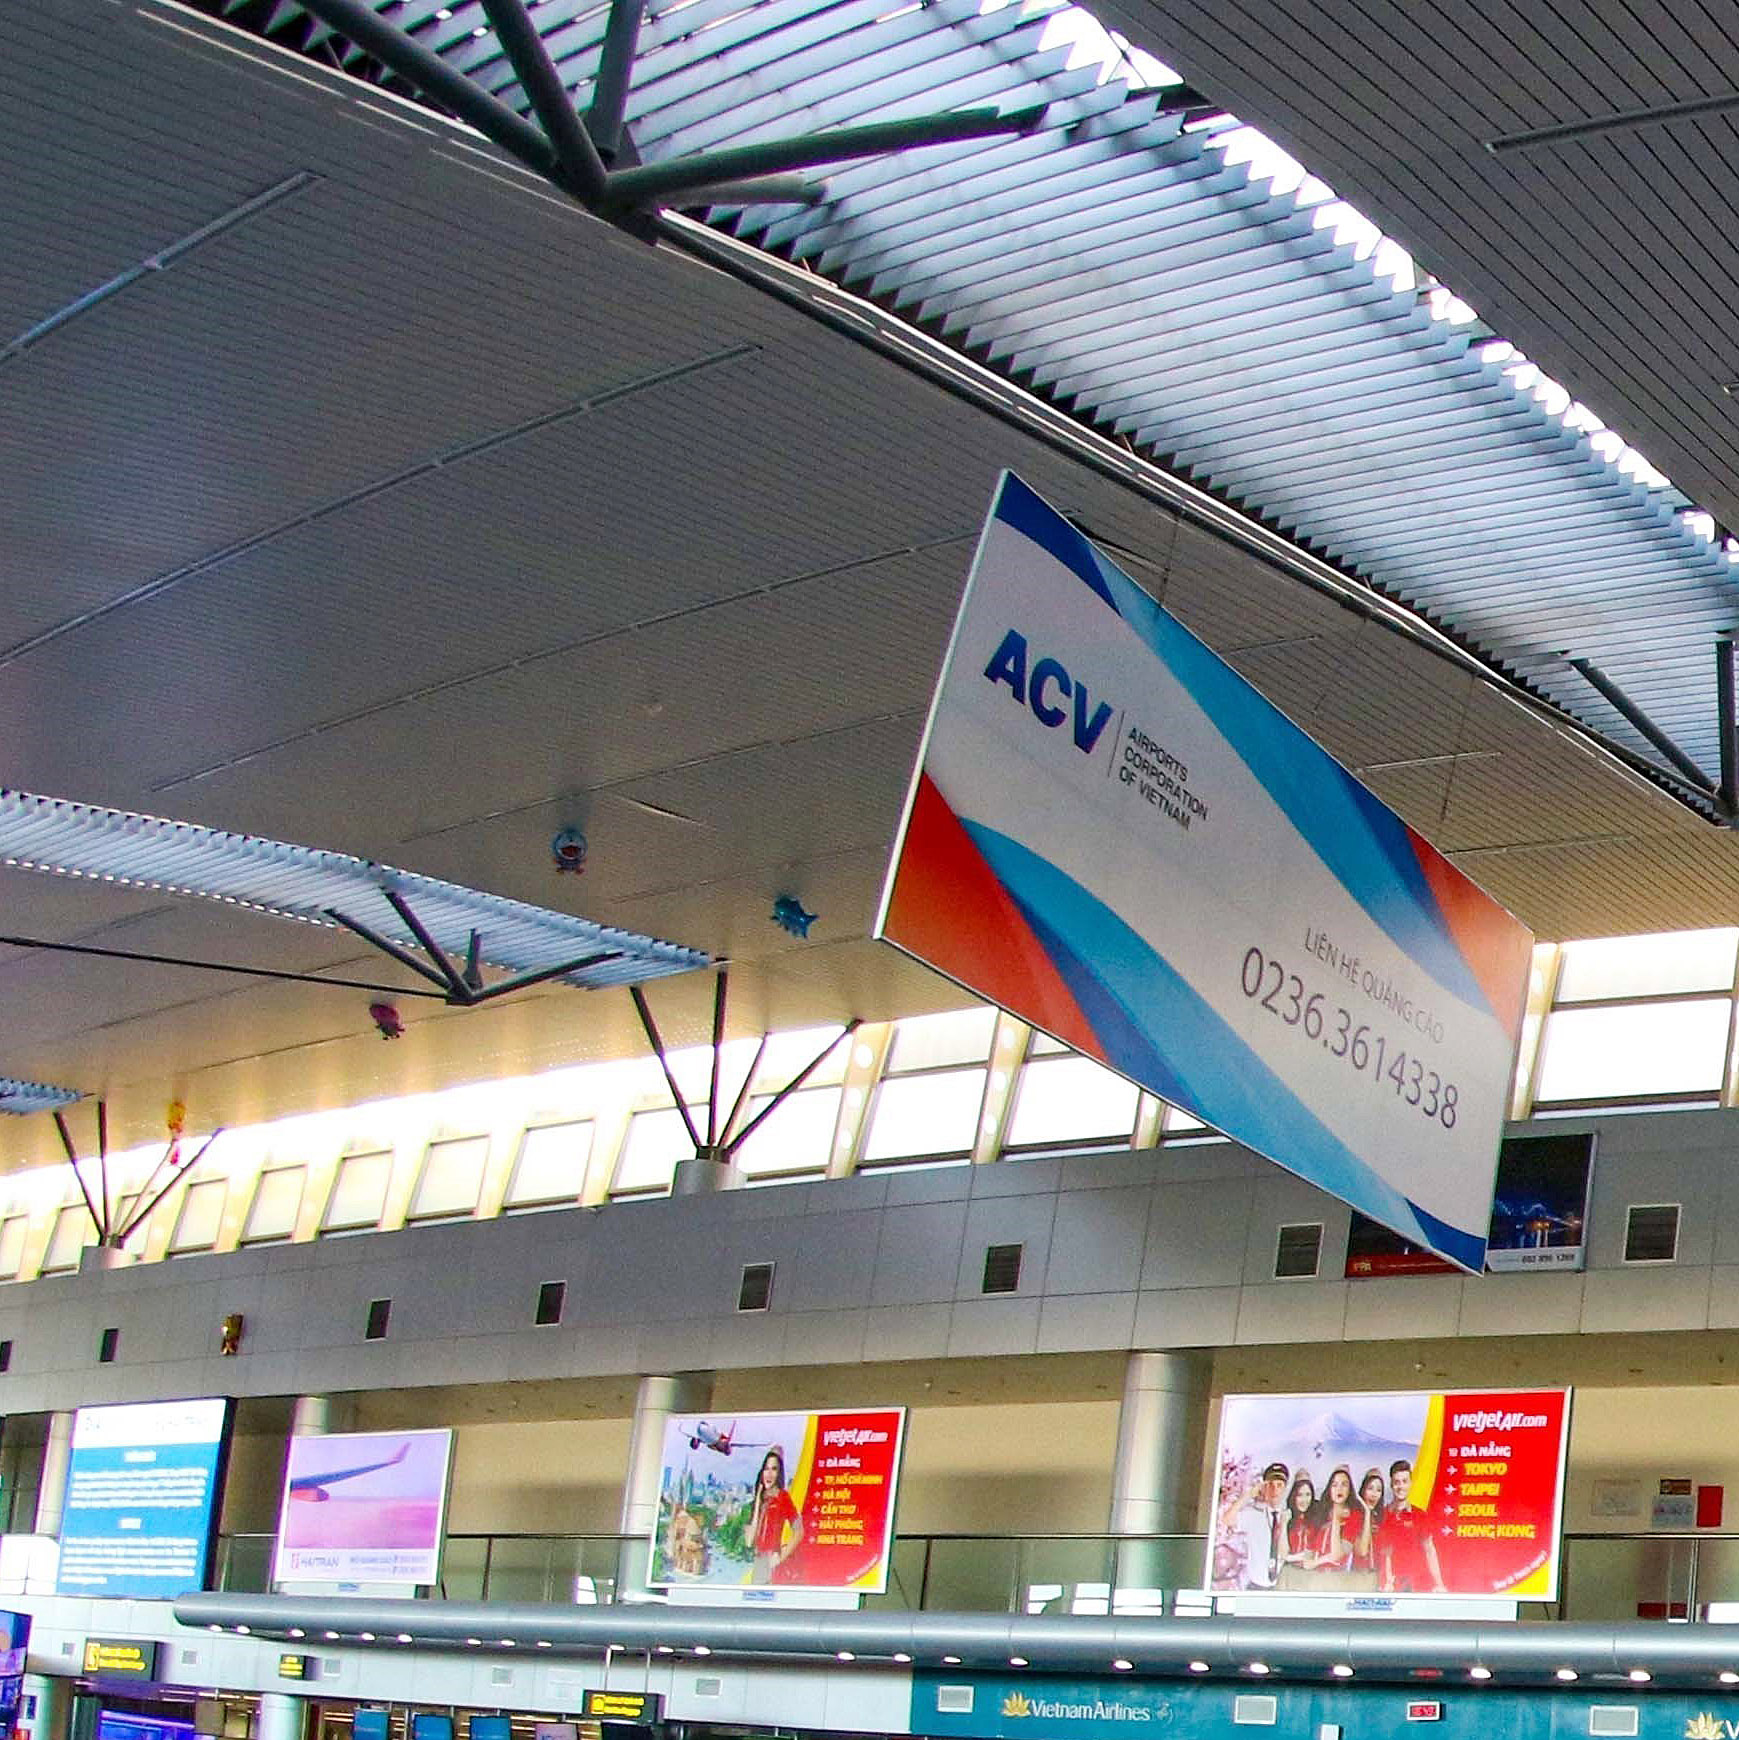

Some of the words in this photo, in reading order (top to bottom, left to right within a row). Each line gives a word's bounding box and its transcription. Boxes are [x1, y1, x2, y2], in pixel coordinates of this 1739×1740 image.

[983, 628, 1114, 754] ACV
[1128, 728, 1189, 782] AIRPORTS
[1119, 766, 1138, 787] OF
[1138, 778, 1192, 831] VIETNAM
[1124, 747, 1208, 820] CORPORATION
[1241, 947, 1459, 1129] 0236.3614338
[1460, 1483, 1501, 1497] TAIPEI
[1464, 1462, 1508, 1476] TOKYO
[1457, 1525, 1495, 1539] HONG
[1496, 1525, 1536, 1539] KONG
[1458, 1504, 1498, 1518] SEOUL
